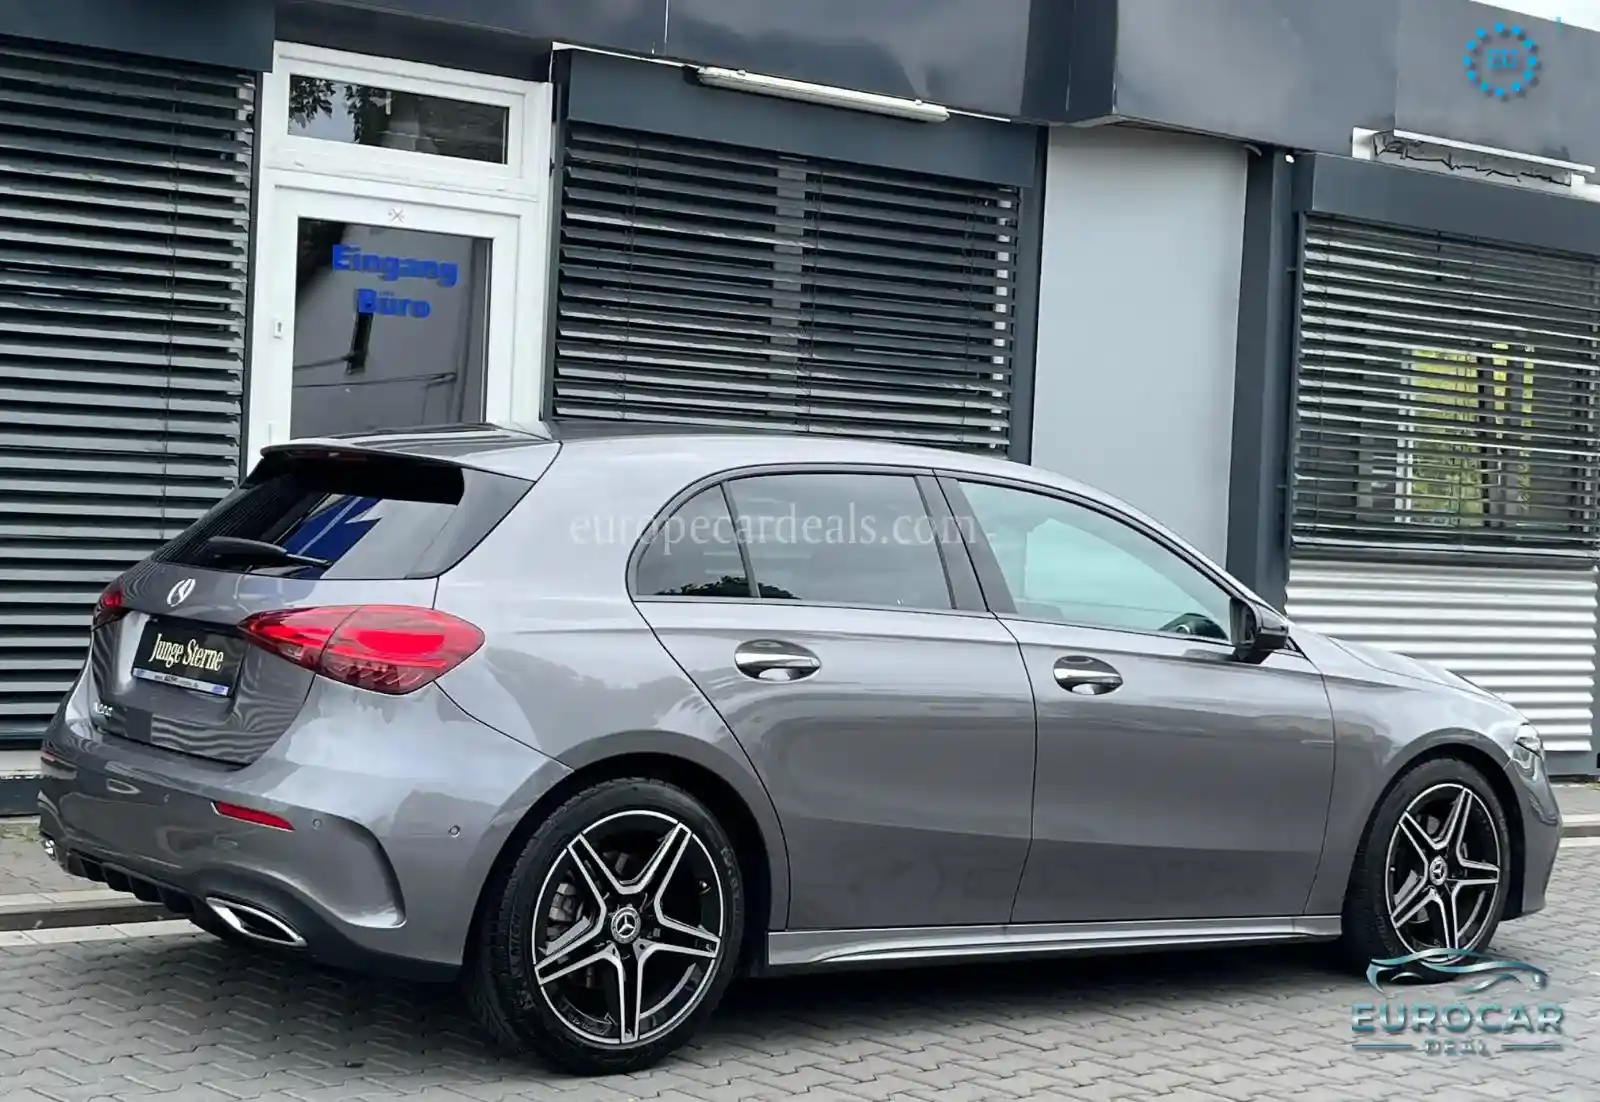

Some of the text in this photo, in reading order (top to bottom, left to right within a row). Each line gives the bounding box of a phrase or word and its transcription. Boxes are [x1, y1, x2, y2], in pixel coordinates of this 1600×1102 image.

[332, 244, 458, 288] Eingang
[356, 288, 431, 318] Büro
[148, 633, 224, 671] Junge Sterne
